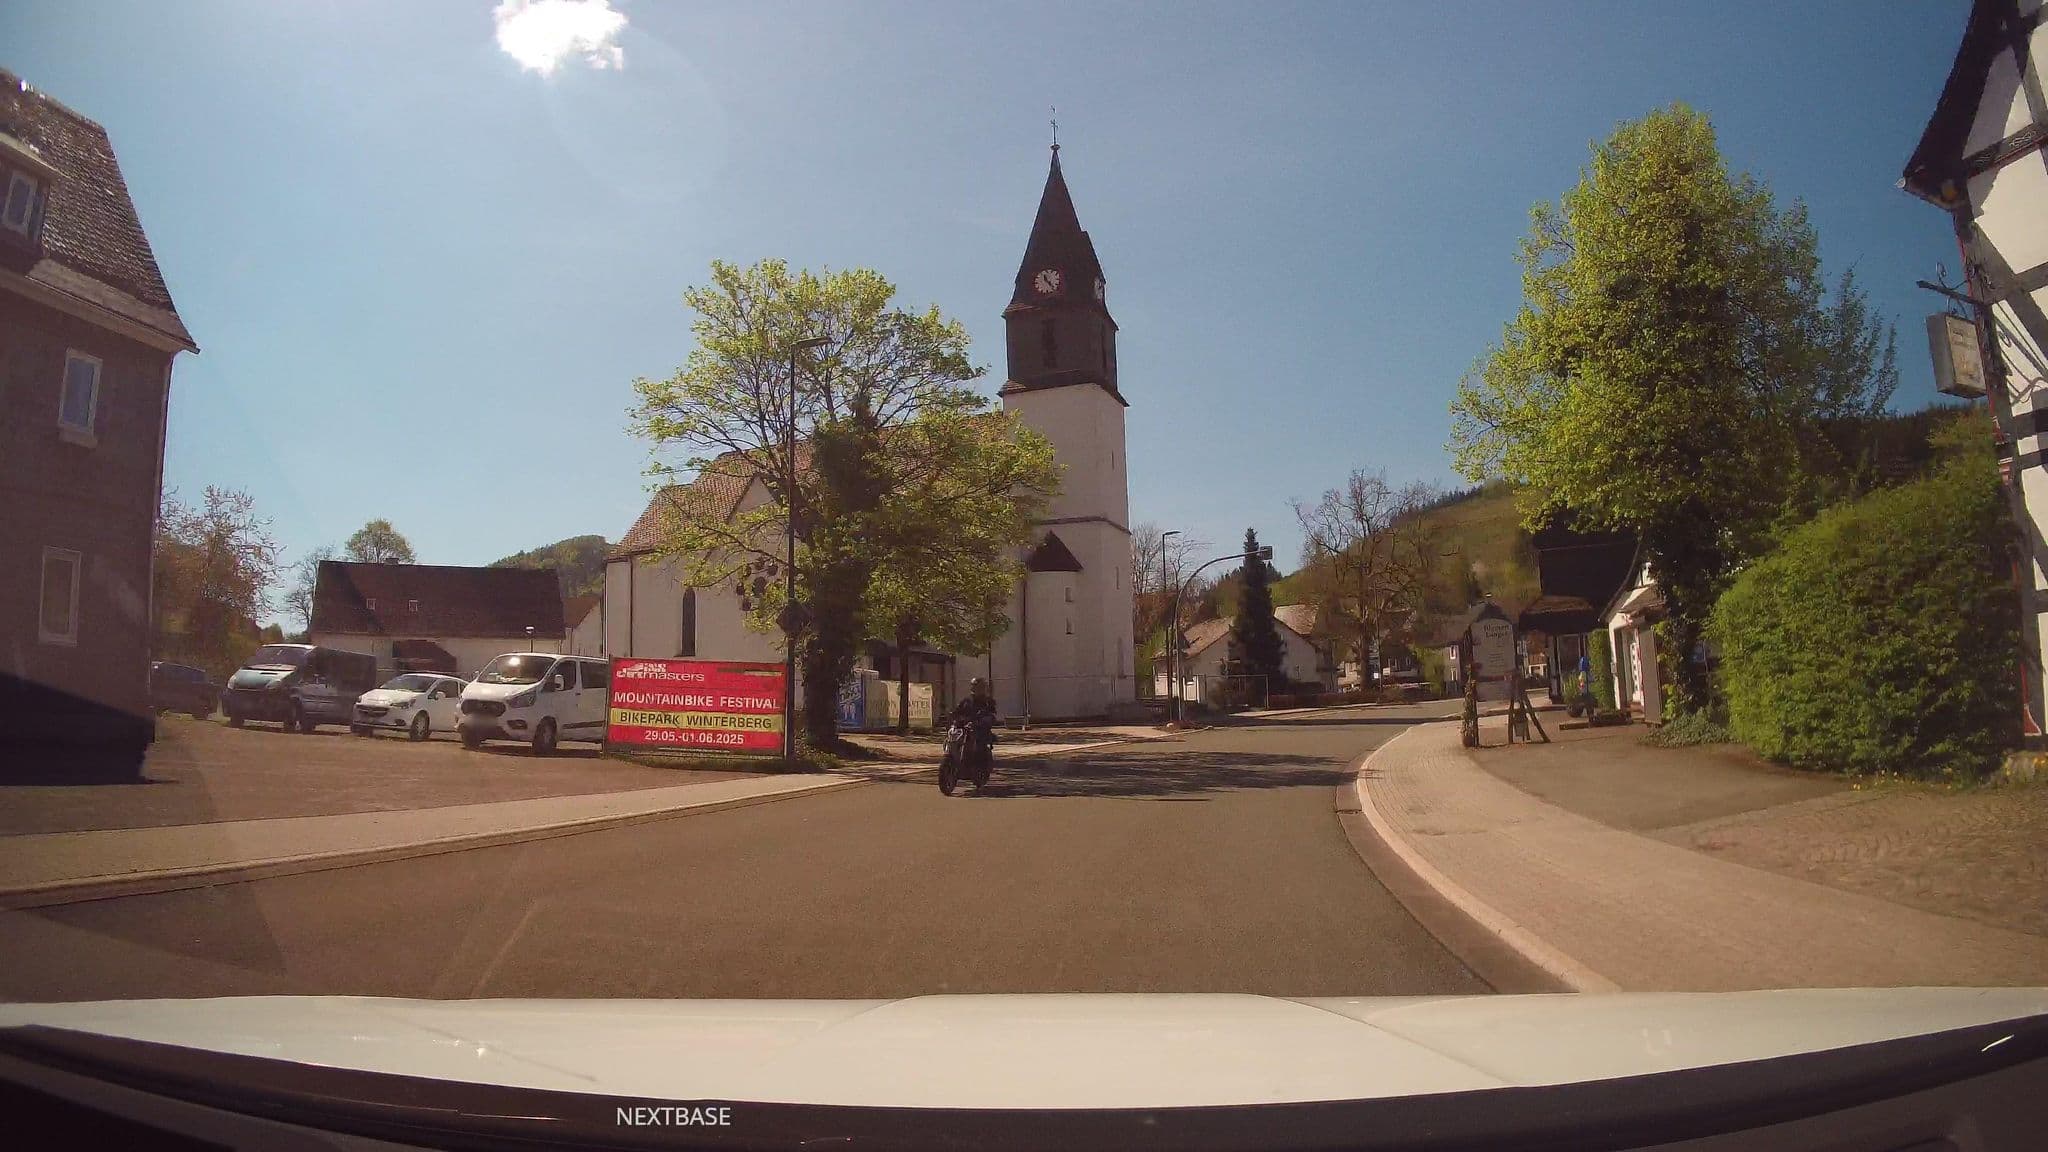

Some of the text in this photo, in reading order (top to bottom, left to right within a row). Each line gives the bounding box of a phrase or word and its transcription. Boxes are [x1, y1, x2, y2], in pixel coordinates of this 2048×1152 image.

[614, 692, 780, 709] MOUNTAINBIKE FESTIVAL
[620, 712, 772, 729] BIKEPARK WINTERBERG
[645, 731, 744, 745] 29.05.-01.06.2025
